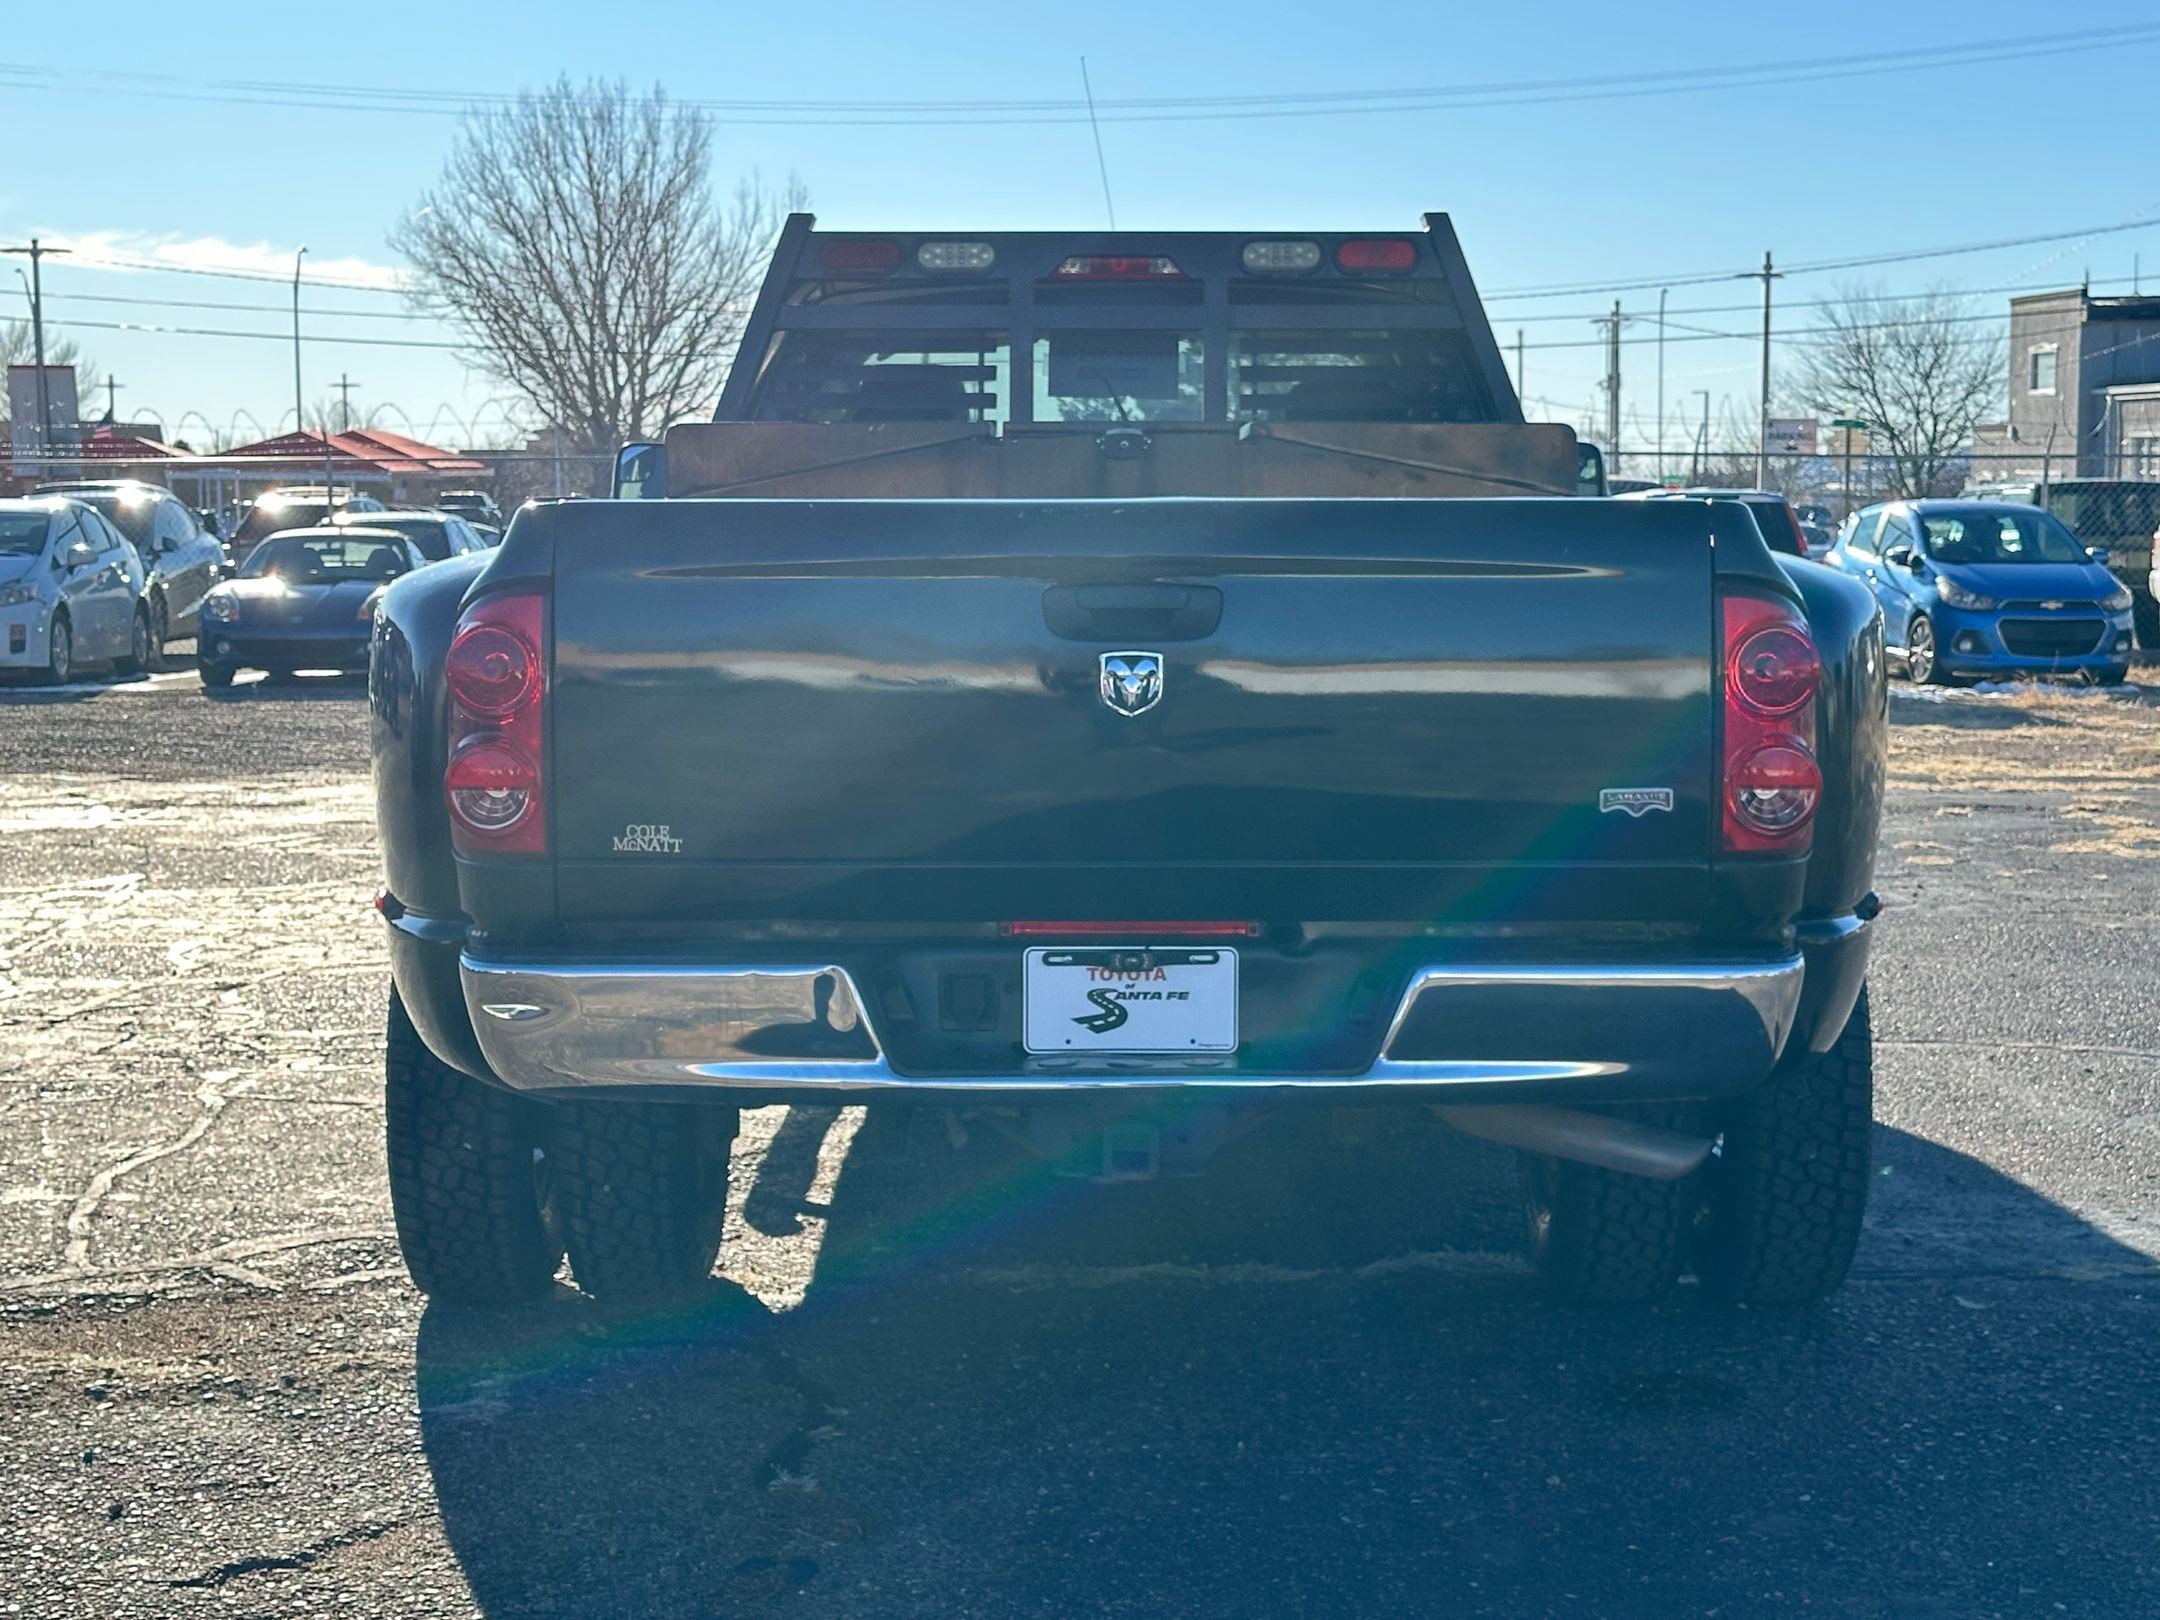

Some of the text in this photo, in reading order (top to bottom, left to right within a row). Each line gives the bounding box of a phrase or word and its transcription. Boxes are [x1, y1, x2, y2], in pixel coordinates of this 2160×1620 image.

[626, 824, 670, 839] COLE
[612, 837, 683, 853] McNATT
[1086, 967, 1167, 982] TOYOTA
[1166, 991, 1190, 1001] FE
